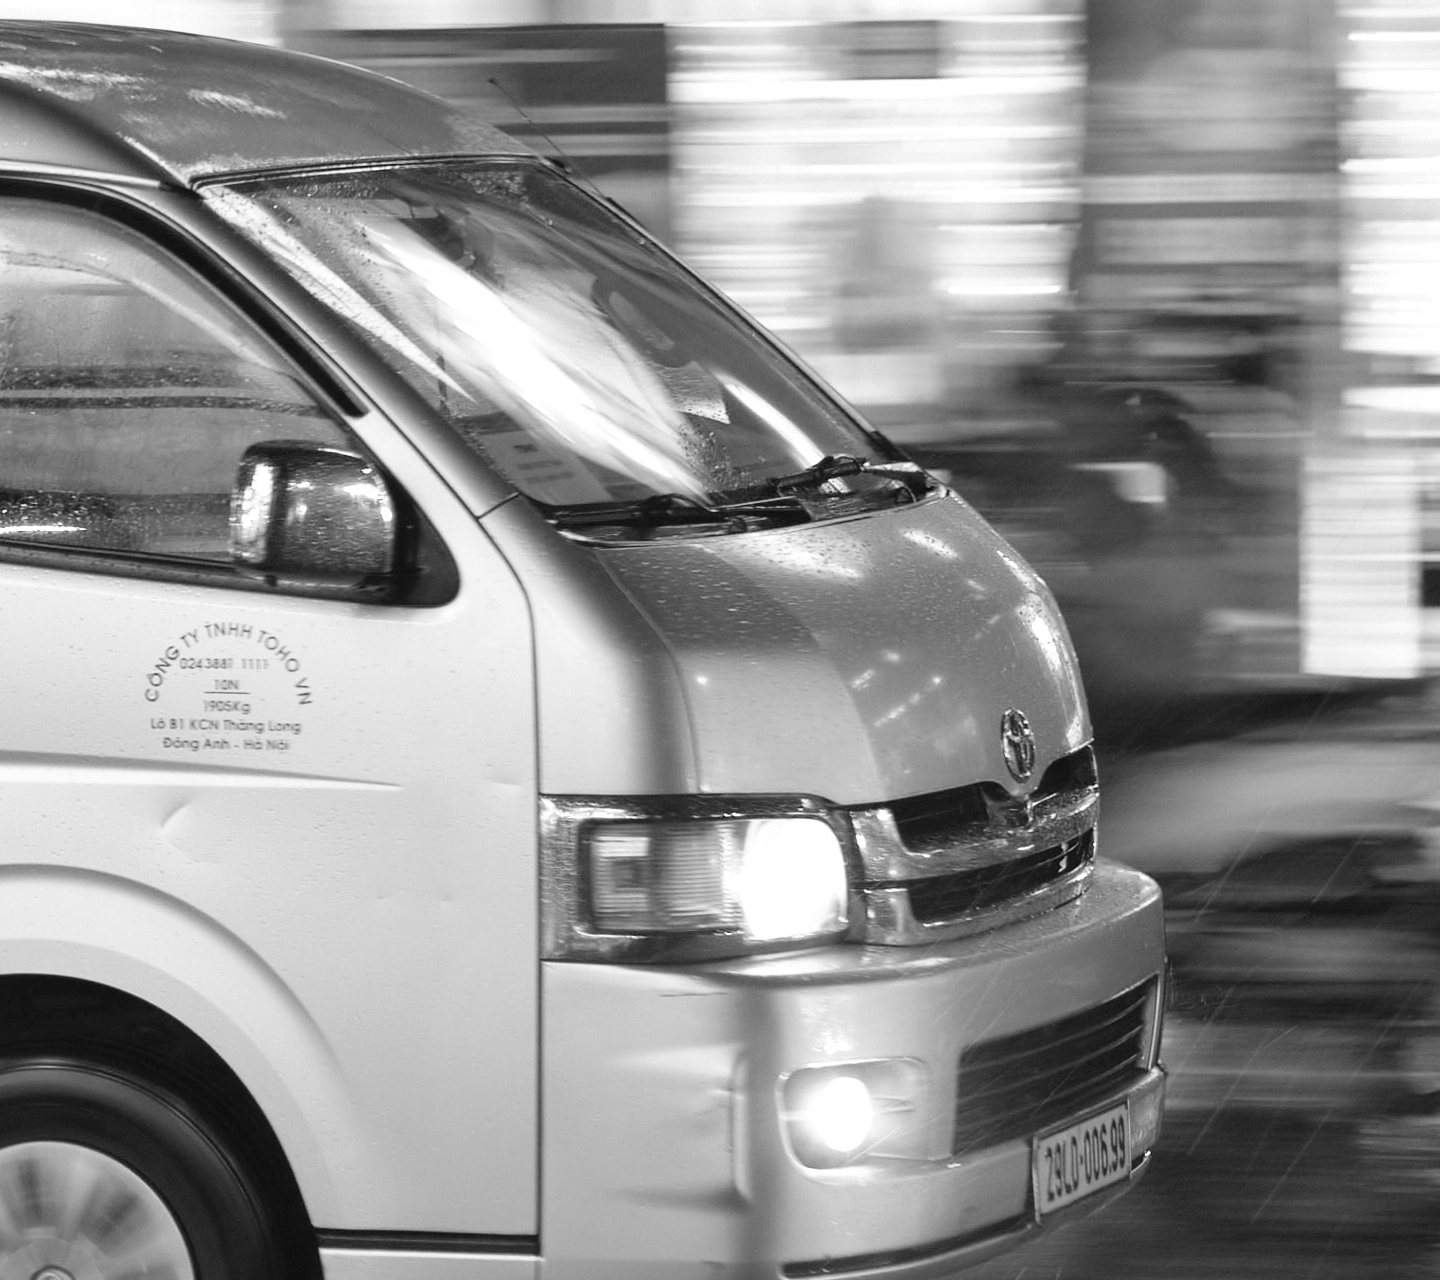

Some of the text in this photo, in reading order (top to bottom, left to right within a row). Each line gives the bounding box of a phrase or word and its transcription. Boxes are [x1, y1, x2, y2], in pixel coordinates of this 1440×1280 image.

[144, 622, 313, 706] CÔNG TY TNHH TOHO VN
[214, 679, 240, 690] 10N
[150, 717, 166, 729] Lô
[169, 718, 184, 729] B1
[189, 719, 219, 730] KCN
[268, 720, 303, 735] Long
[163, 737, 199, 752] Đông
[203, 739, 231, 749] Anh
[244, 738, 263, 750] Hà
